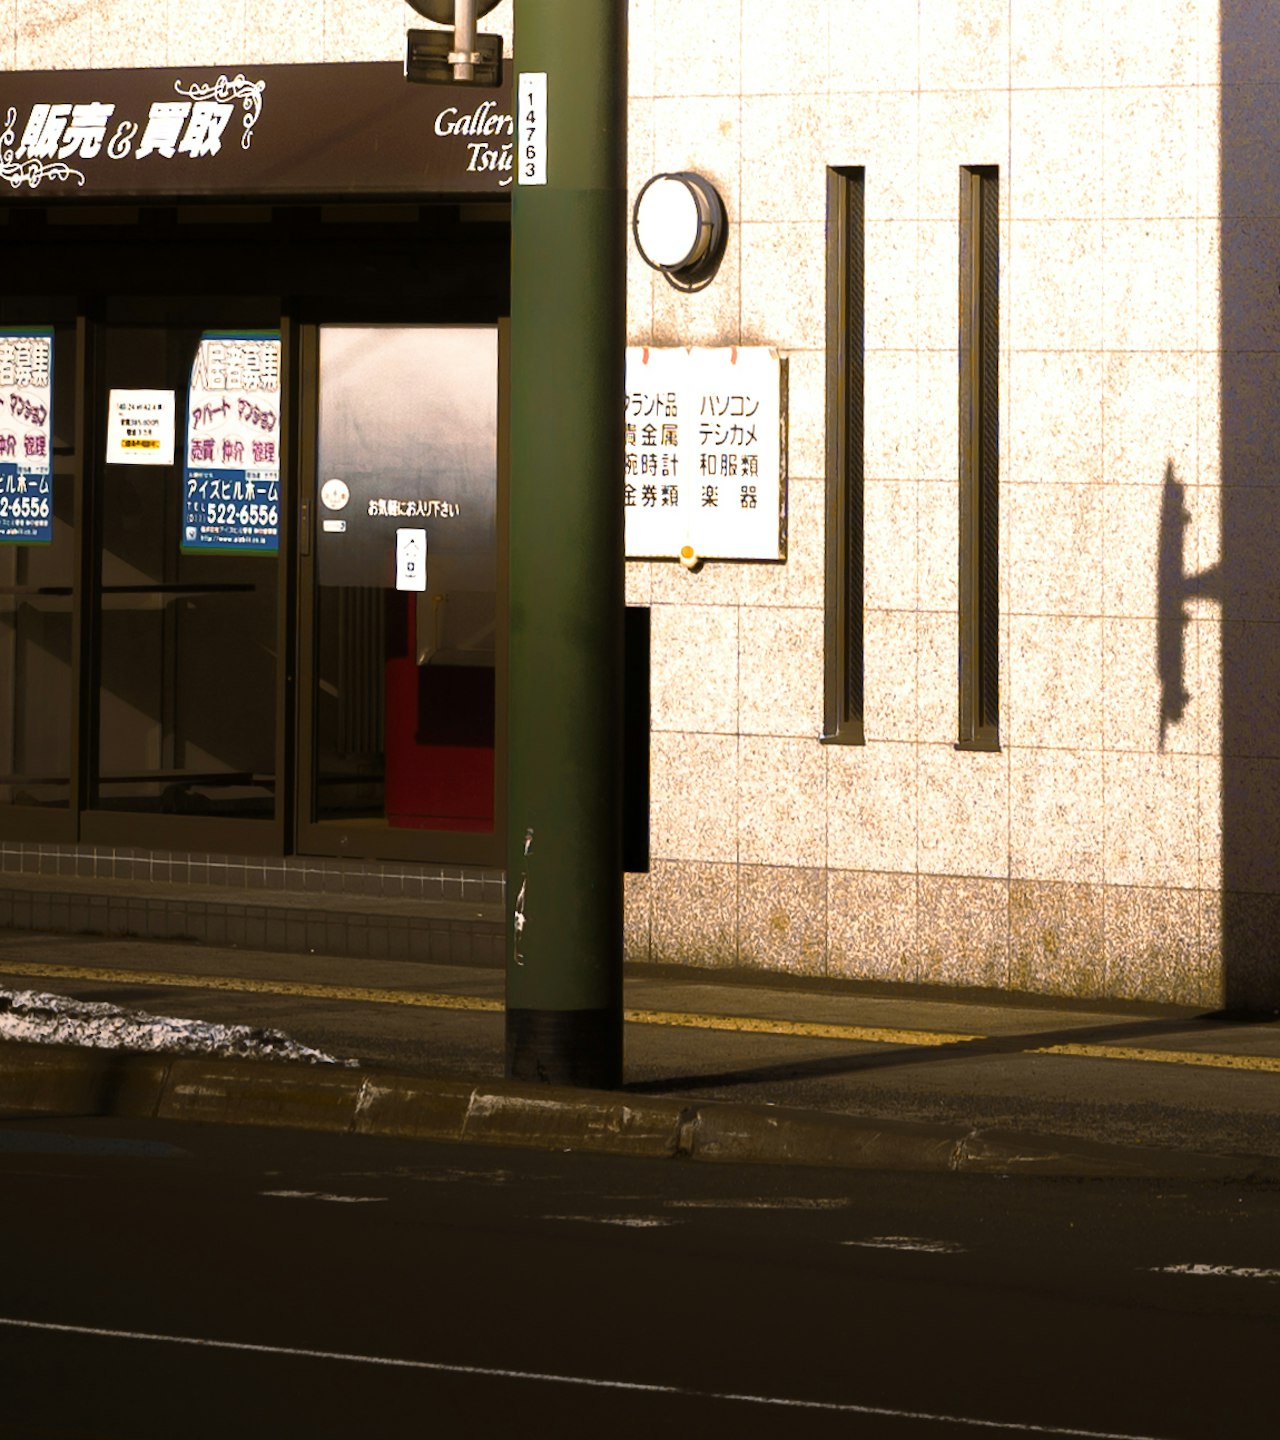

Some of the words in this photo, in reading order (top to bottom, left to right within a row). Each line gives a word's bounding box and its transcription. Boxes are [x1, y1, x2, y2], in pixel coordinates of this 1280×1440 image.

[525, 92, 536, 178] 14763
[192, 396, 231, 430] アパート
[699, 453, 759, 477] 和服類
[367, 497, 460, 519] お気軽にお入り下さい
